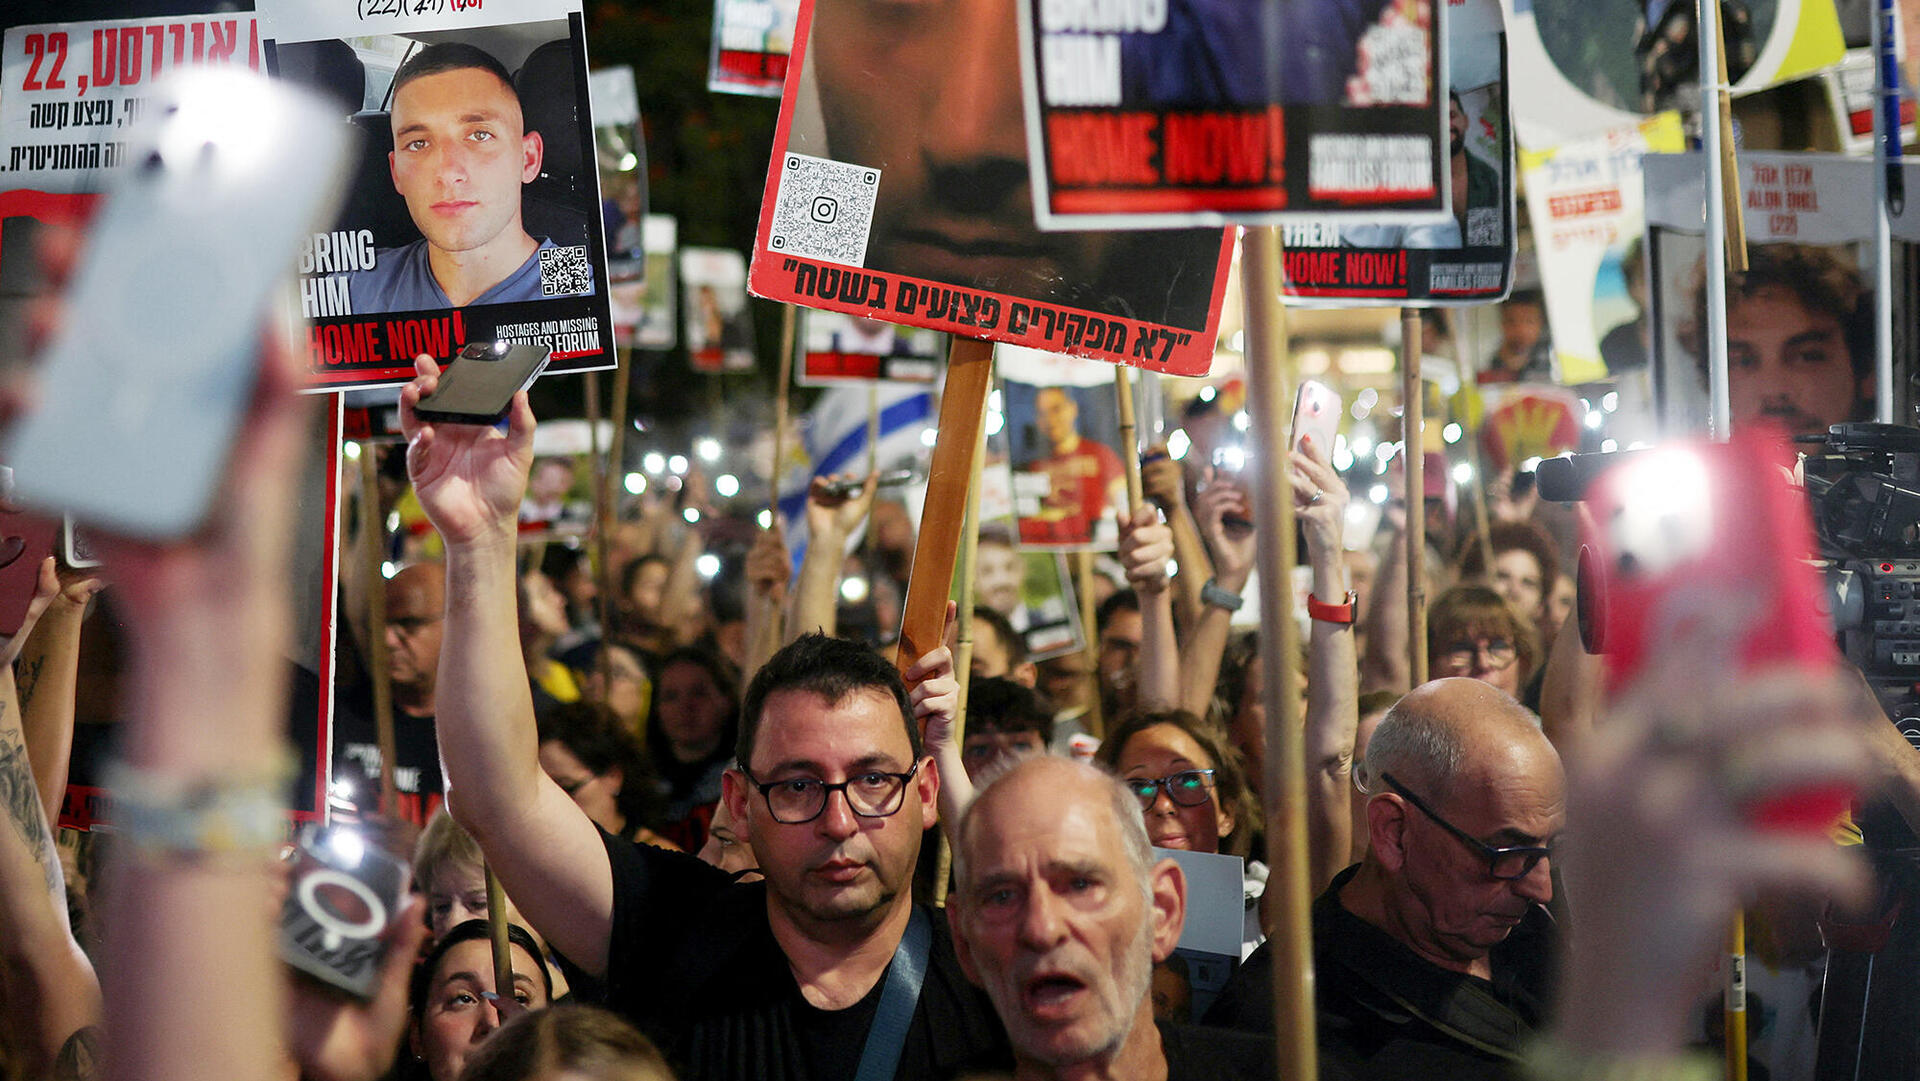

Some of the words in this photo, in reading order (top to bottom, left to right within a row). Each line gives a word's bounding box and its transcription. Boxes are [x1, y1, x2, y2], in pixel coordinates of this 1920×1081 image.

[22, 32, 68, 91] 22
[30, 102, 69, 130] קשה
[72, 100, 113, 127] נפצע
[299, 229, 376, 274] BRING
[1282, 251, 1339, 285] HOME
[1345, 248, 1407, 286] NOW!
[300, 276, 352, 319] HIM
[895, 280, 1001, 329] פצועים
[305, 322, 384, 367] HOME
[386, 310, 467, 361] NOW!
[496, 322, 540, 339] HOSTAGES
[541, 320, 559, 335] AND
[560, 317, 599, 333] MISSING
[555, 331, 600, 353] FORUM
[1007, 302, 1128, 354] מפקירים
